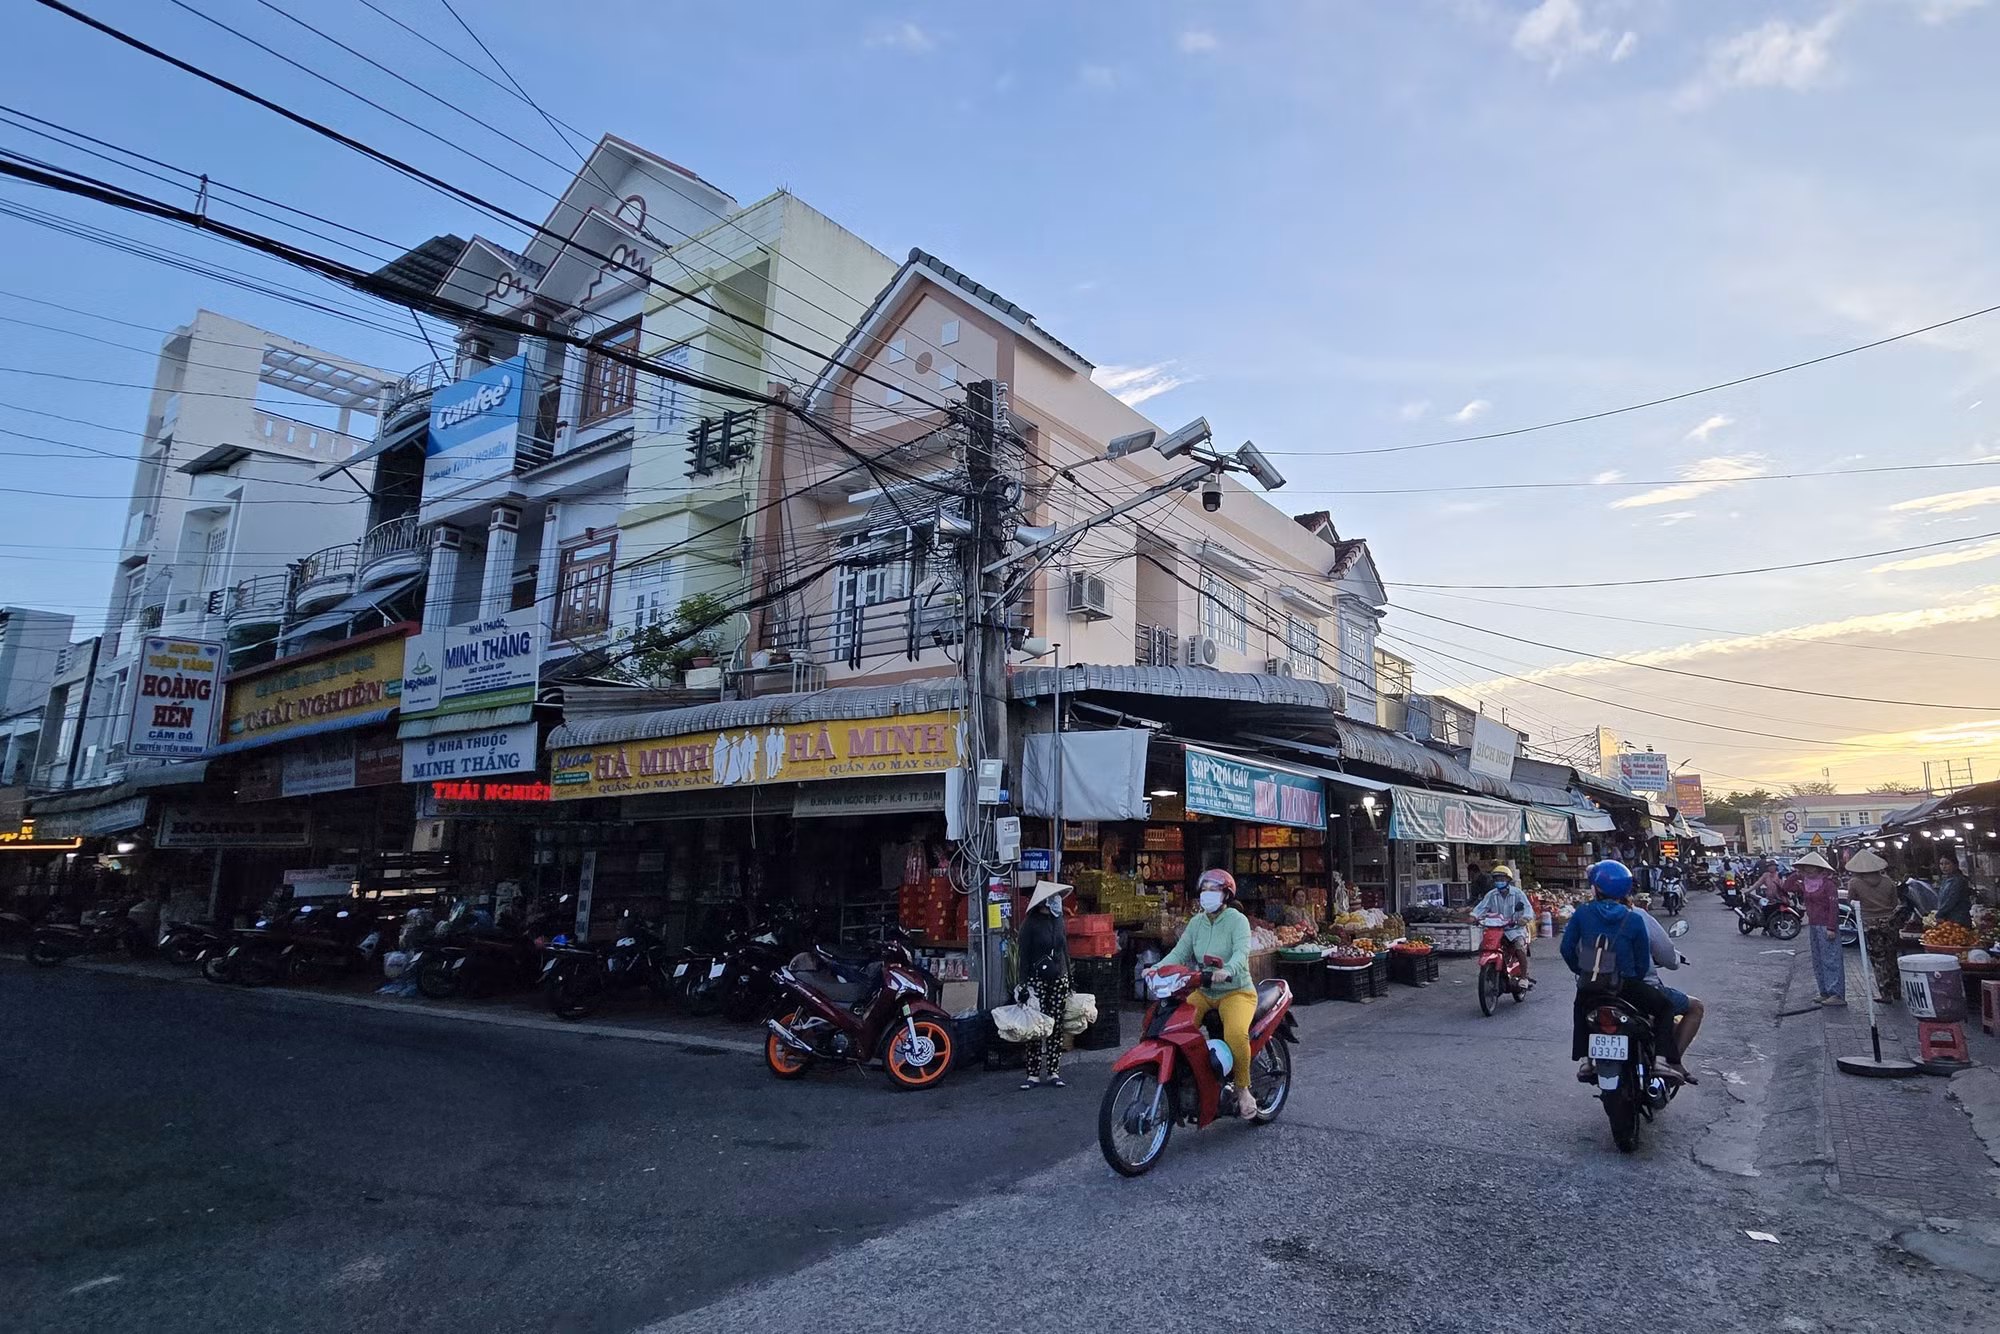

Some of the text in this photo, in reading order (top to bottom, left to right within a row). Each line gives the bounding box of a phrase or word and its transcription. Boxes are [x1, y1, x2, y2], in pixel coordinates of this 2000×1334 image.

[445, 626, 532, 671] MINH THẮNG
[142, 672, 212, 701] HOÀNG
[297, 678, 385, 717] NGHIÊN
[151, 701, 195, 728] HẾN
[148, 730, 175, 740] CẦM
[438, 730, 508, 753] NHÀ THUỐC
[848, 723, 949, 758] MINH
[411, 747, 521, 779] MINH THẮNG
[639, 743, 714, 777] MINH
[1476, 740, 1496, 761] BÍCH
[889, 758, 919, 769] MAY
[1191, 759, 1210, 782] SẠP
[1232, 767, 1250, 788] CÂY
[432, 779, 480, 799] THÁI
[654, 778, 682, 789] MAY
[1591, 1046, 1626, 1058] 033.76
[1595, 1036, 1622, 1047] 69-F1
